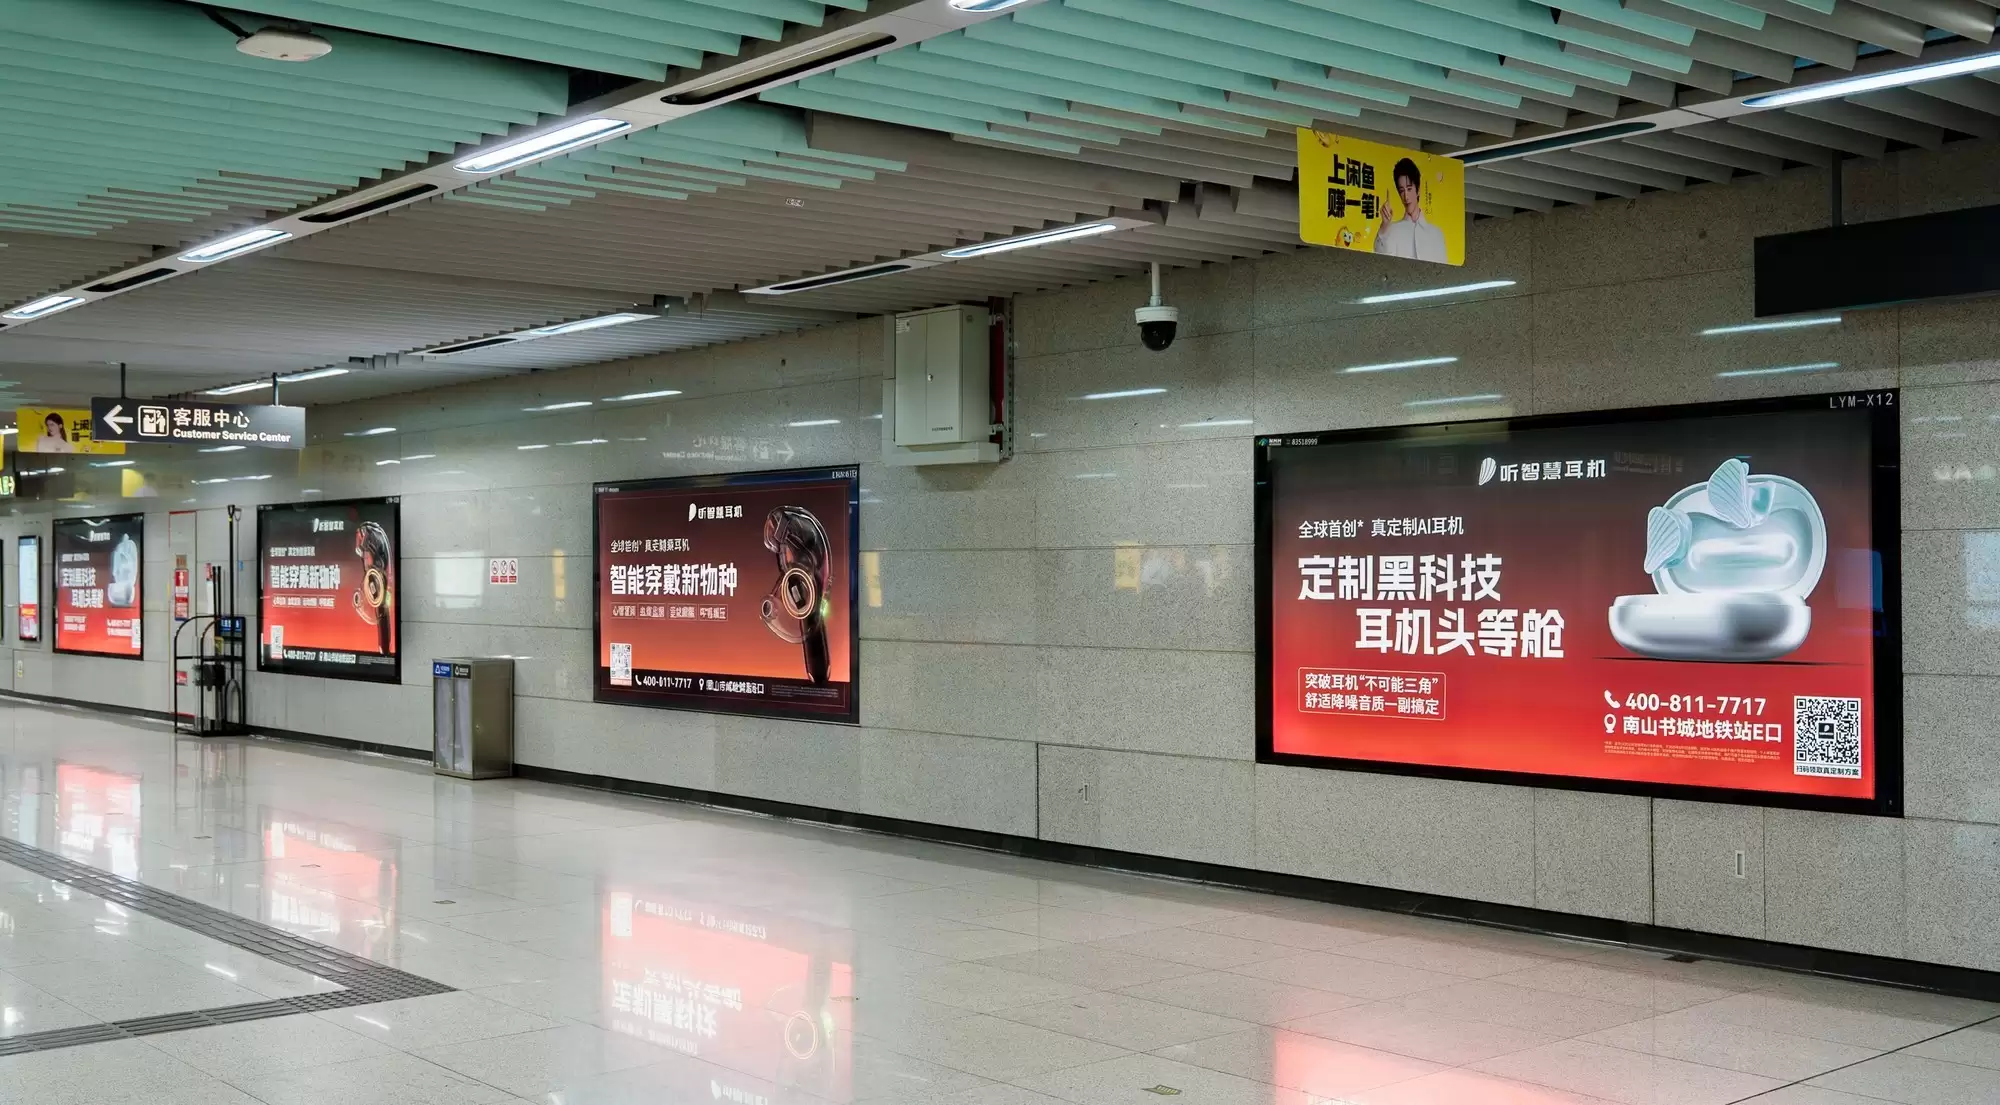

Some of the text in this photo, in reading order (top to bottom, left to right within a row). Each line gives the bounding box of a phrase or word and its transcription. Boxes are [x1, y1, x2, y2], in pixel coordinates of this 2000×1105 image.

[1328, 154, 1374, 190] 上闲鱼
[1830, 393, 1893, 408] LYM-X12
[173, 408, 250, 429] 客服中心
[173, 428, 291, 443] Customer Service Center
[1500, 459, 1606, 482] 听智慧耳机
[1371, 516, 1464, 538] 真定制AI耳机
[610, 562, 738, 597] 智能穿戴新物种
[1298, 553, 1502, 602] 定制黑科技
[1355, 607, 1565, 658] 耳机头等舱
[1305, 673, 1439, 695] 突破耳机“不可能三角”
[1305, 693, 1439, 716] 舒适降噪音质一副搞定
[1625, 692, 1766, 716] 400-811-7717
[1622, 715, 1782, 743] 南山书城地铁站E口
[1796, 765, 1859, 776] 扫码领取真定制方案
